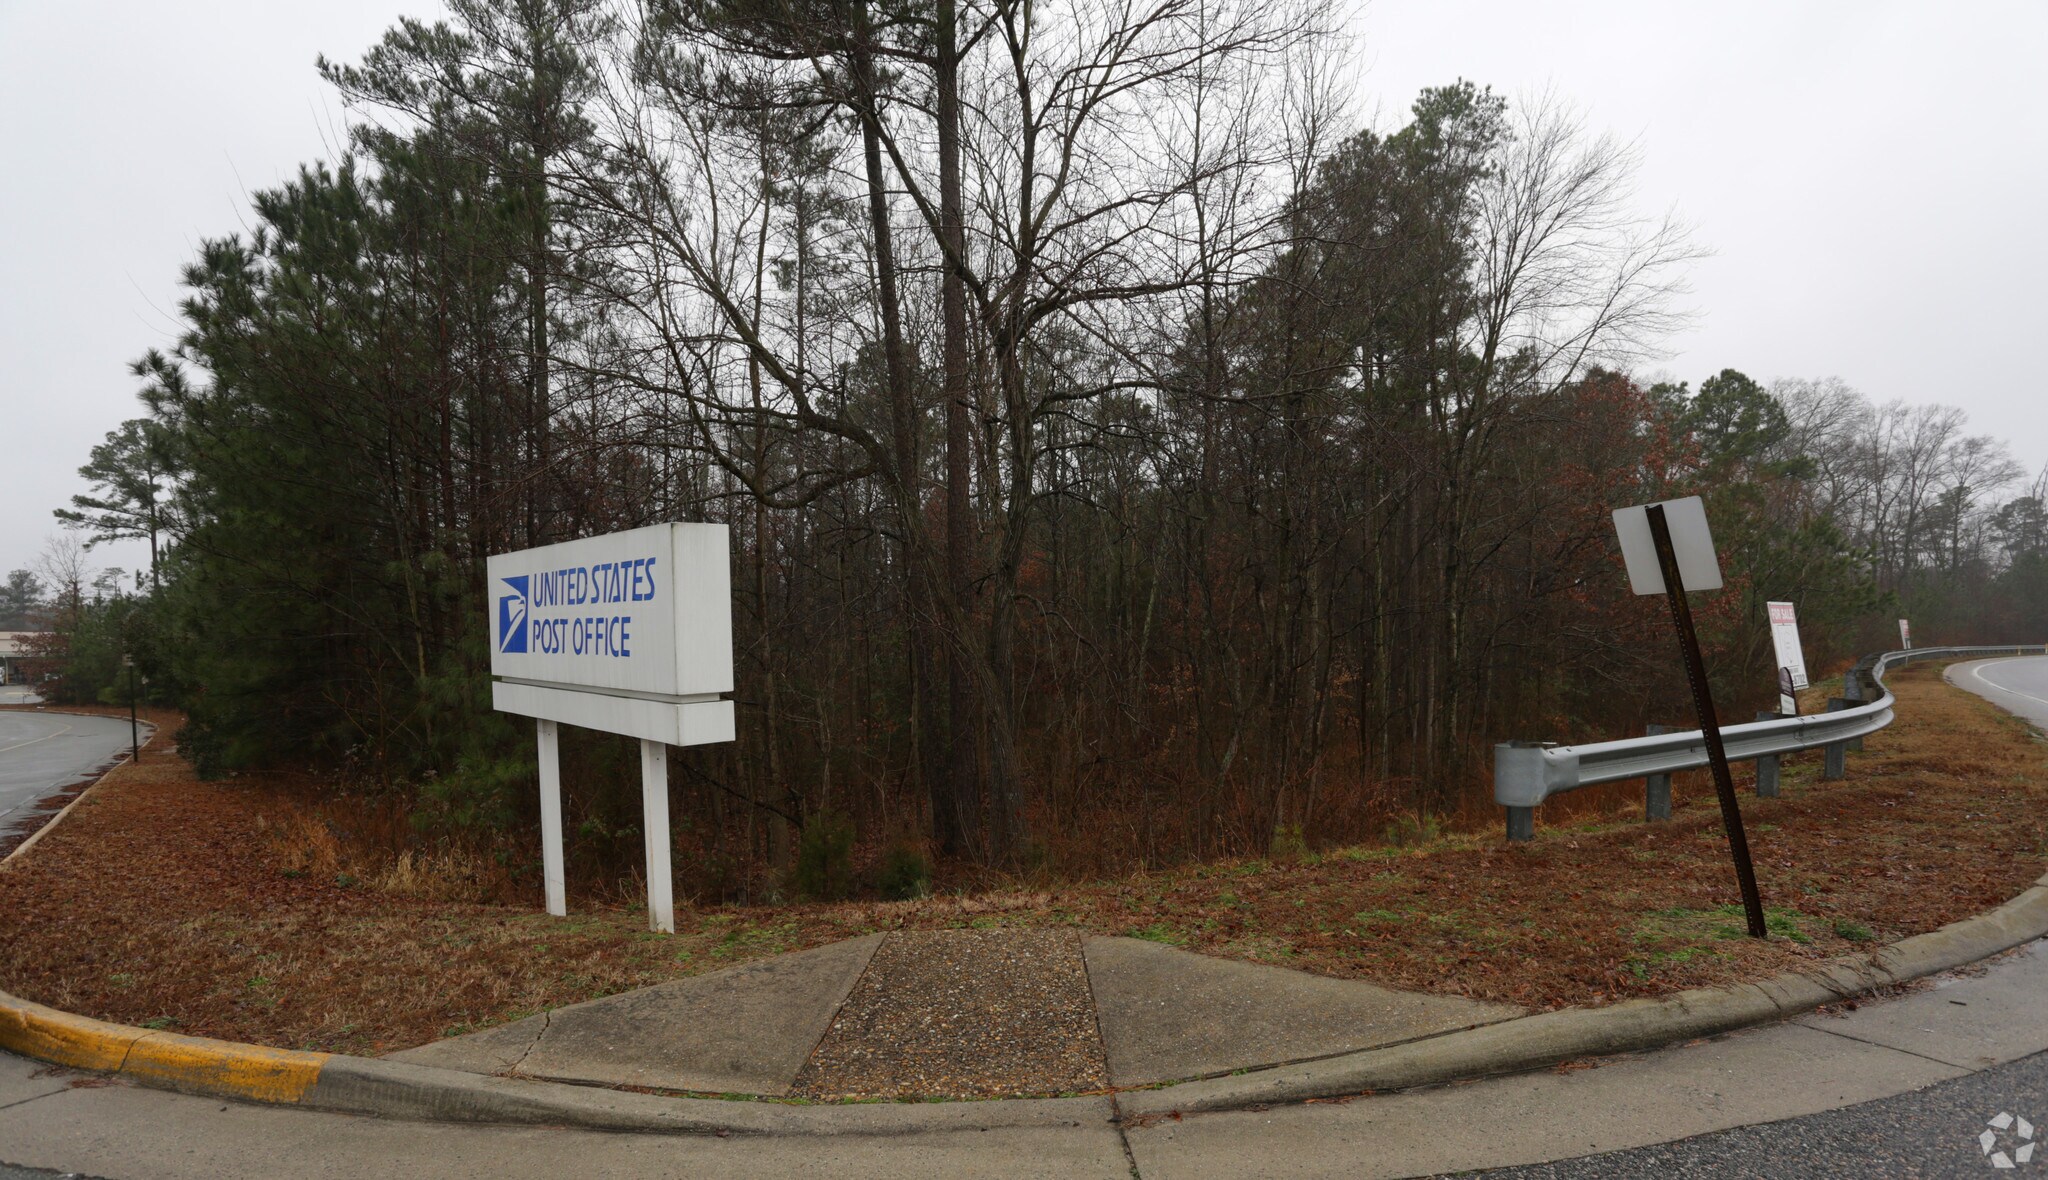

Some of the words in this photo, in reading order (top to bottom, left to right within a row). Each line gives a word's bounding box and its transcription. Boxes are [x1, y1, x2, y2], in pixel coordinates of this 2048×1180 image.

[533, 567, 588, 608] UNITED
[591, 557, 657, 604] STATES
[532, 618, 569, 654] POST
[572, 616, 632, 657] OFFICE
